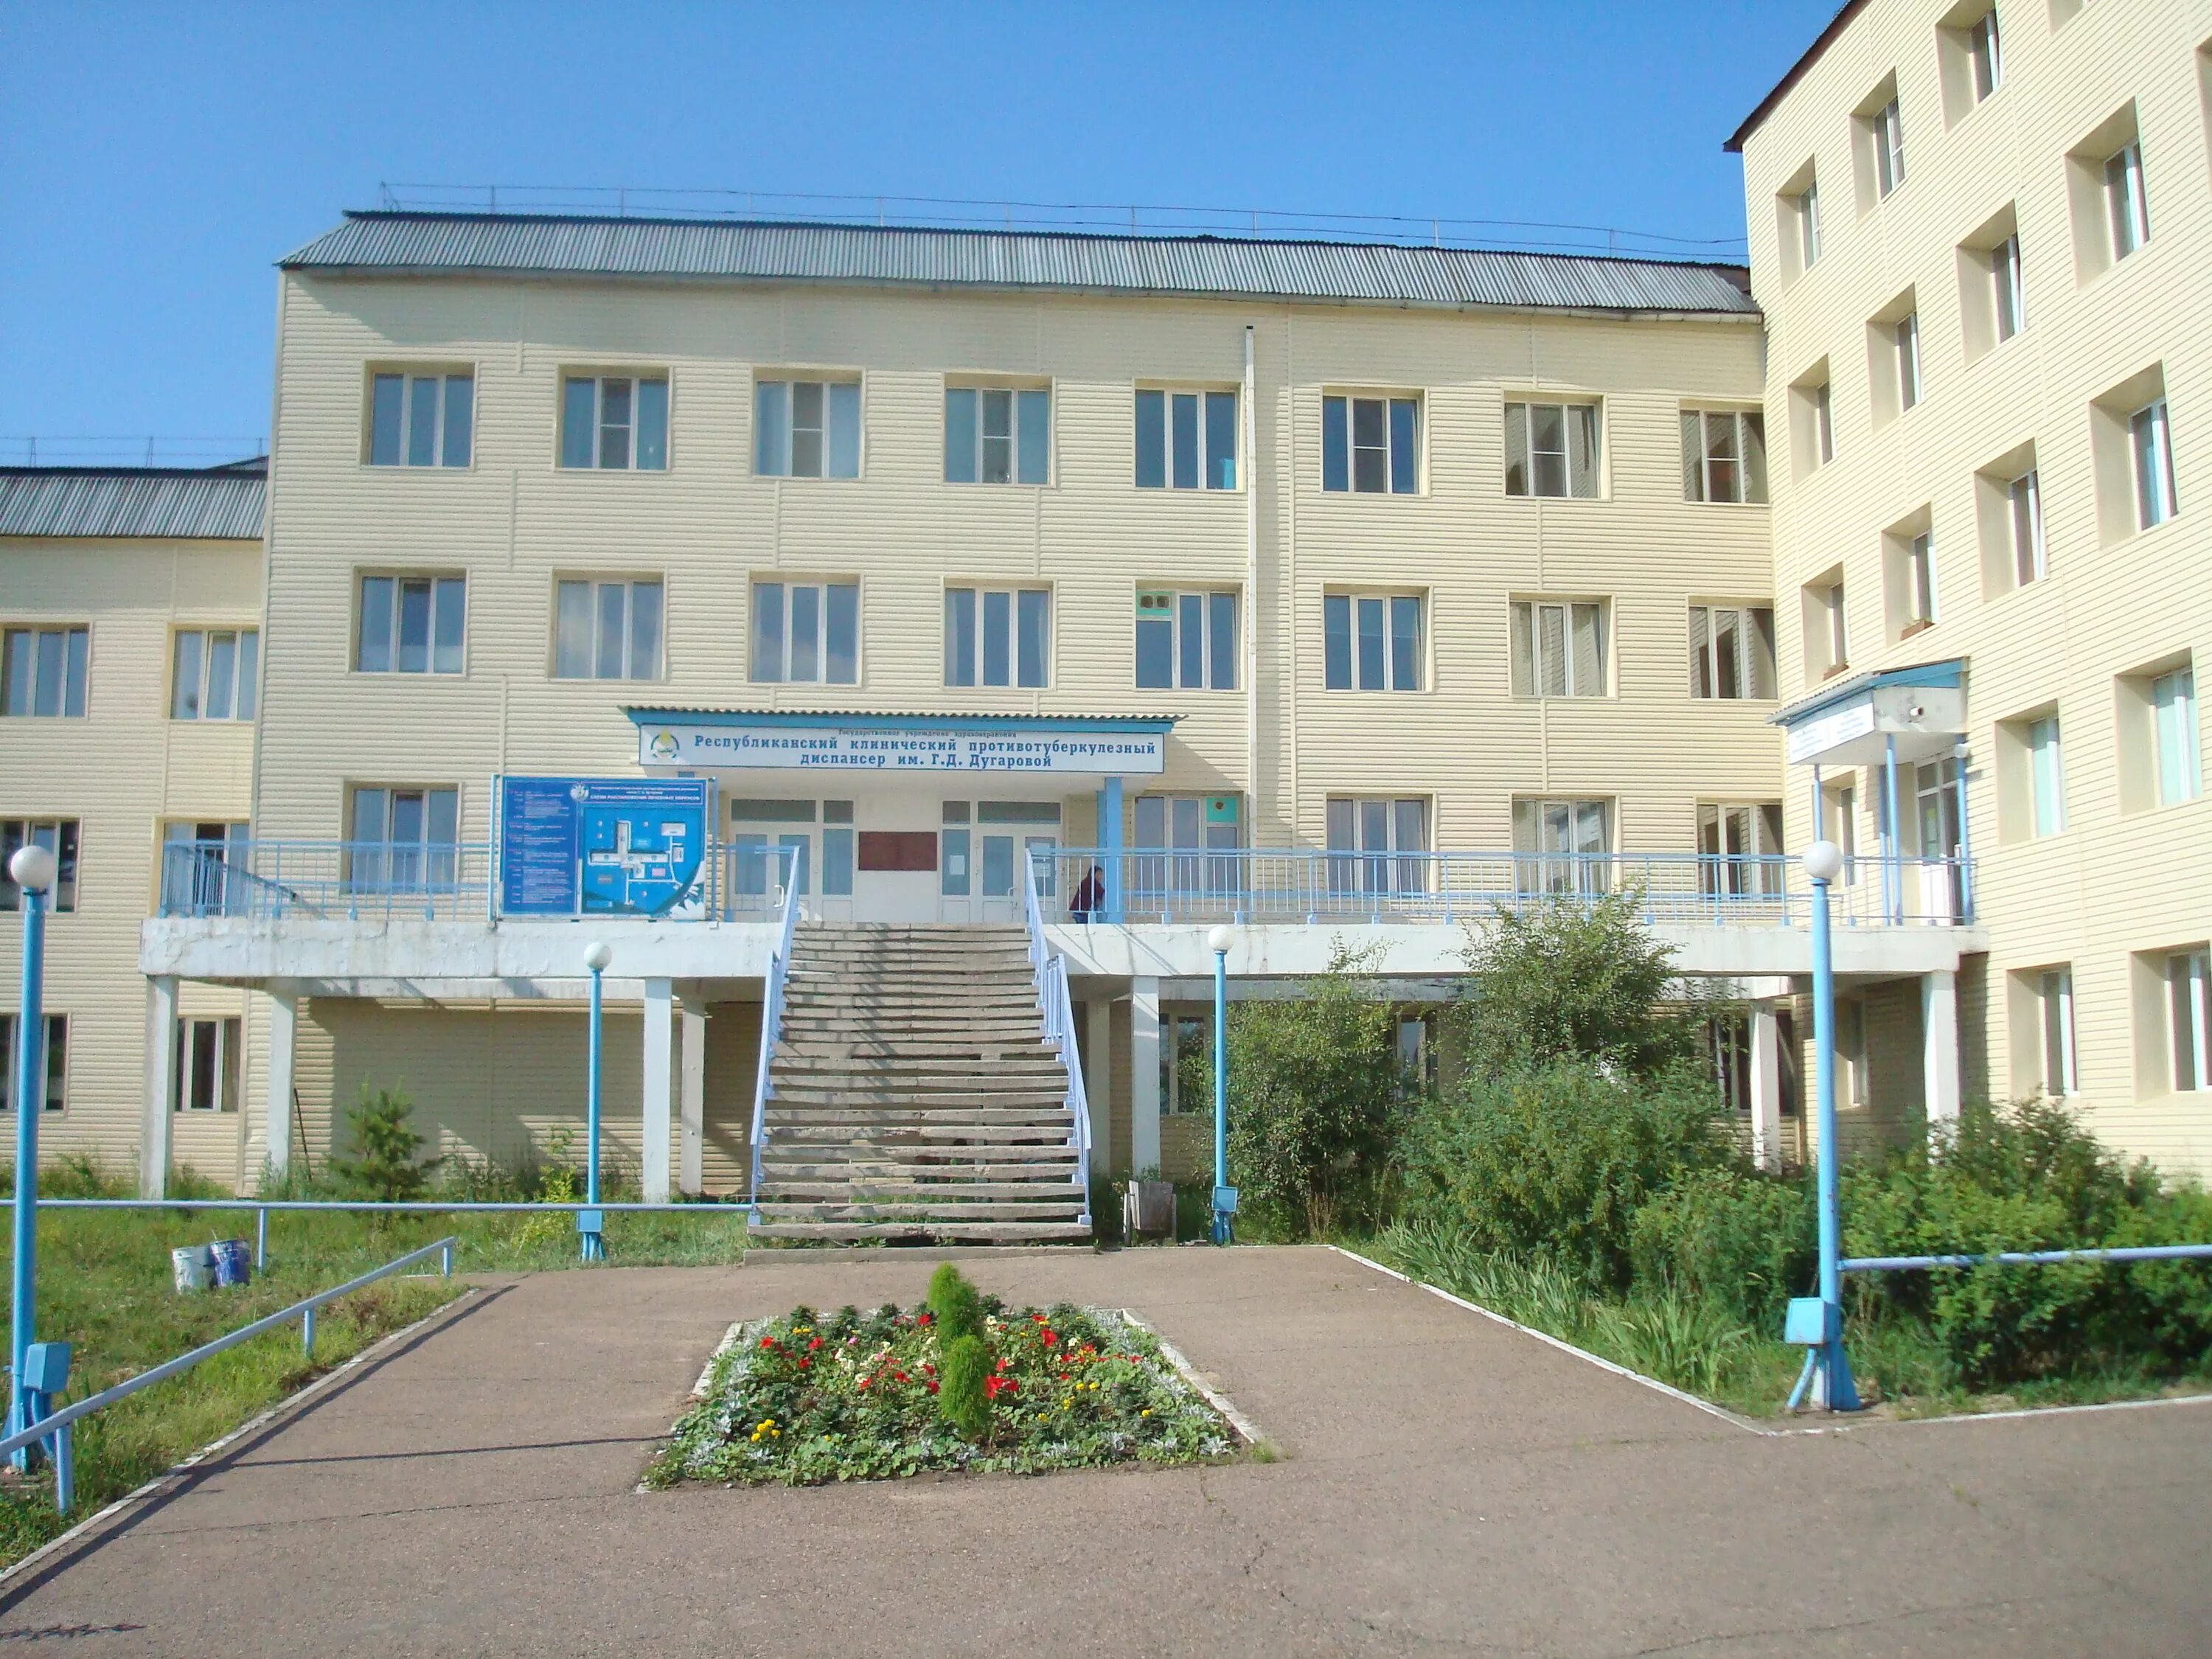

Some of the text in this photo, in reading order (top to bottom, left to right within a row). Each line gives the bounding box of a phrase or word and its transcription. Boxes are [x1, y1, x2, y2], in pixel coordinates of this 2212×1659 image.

[695, 734, 1155, 757] Республиканский клинический противотуберкулезный
[801, 753, 1051, 769] диспансер им. Г.Д. Дугаровой
